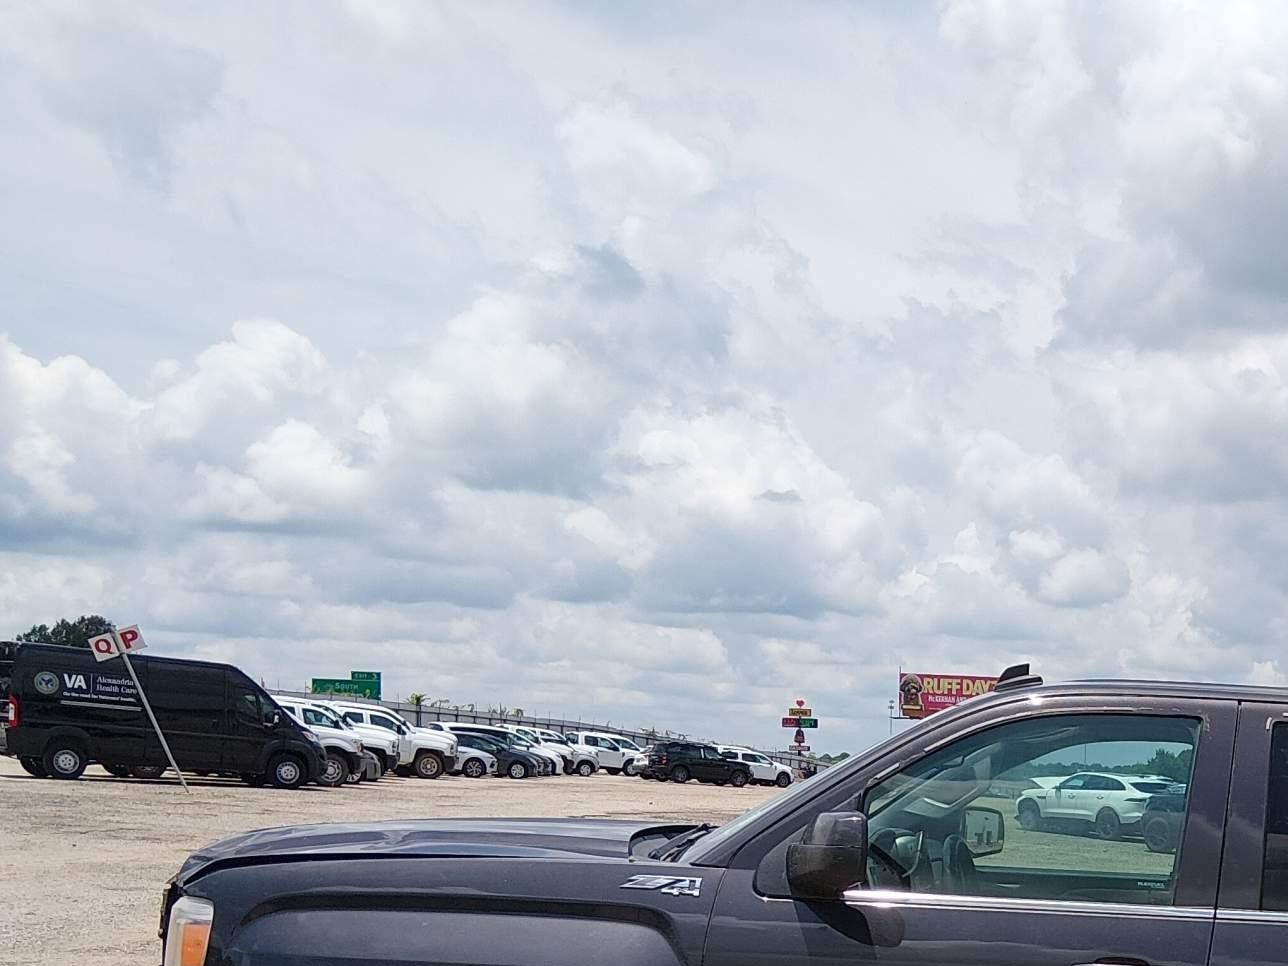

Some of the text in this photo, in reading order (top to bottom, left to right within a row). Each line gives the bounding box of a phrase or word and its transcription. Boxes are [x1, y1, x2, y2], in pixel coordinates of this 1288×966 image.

[94, 638, 115, 655] Q
[119, 630, 138, 650] P
[63, 673, 88, 690] VA
[96, 676, 134, 686] Alexandria
[96, 684, 138, 694] Health Care
[923, 677, 962, 695] RUFF
